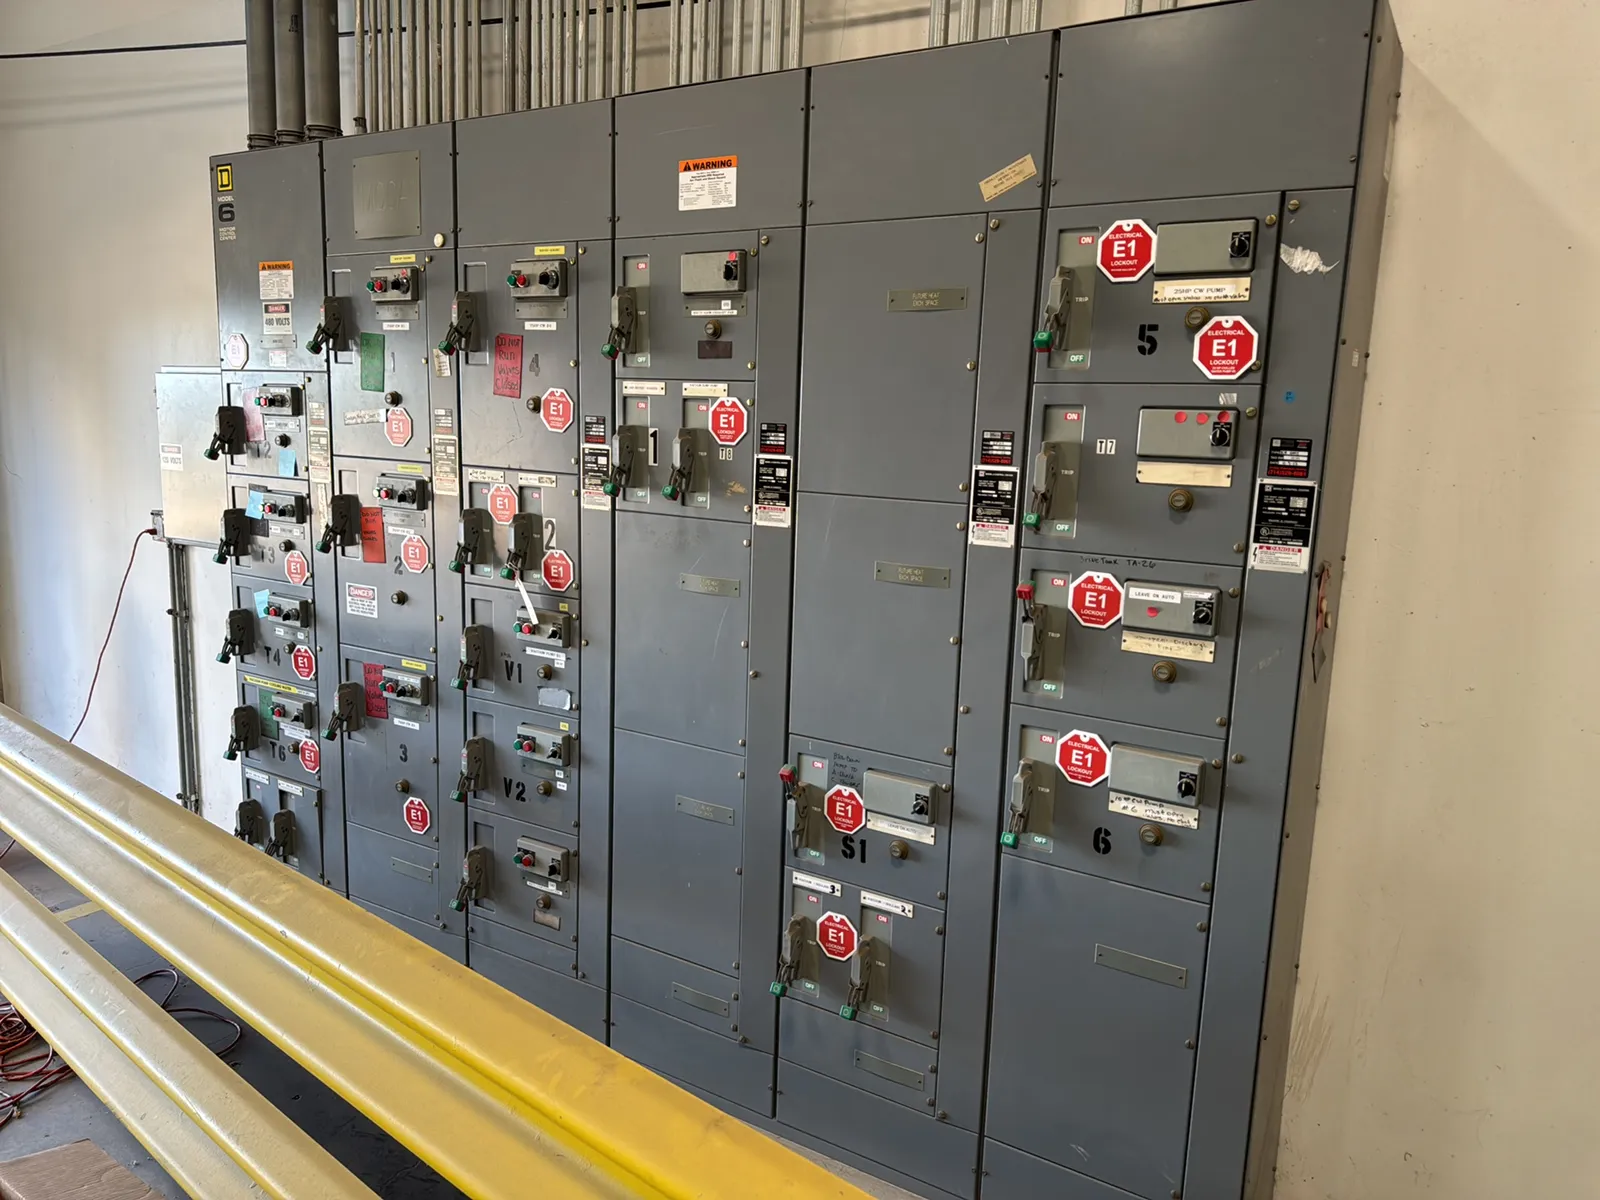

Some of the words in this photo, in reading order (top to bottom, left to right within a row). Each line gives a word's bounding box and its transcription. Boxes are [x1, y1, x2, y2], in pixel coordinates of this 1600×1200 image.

[692, 160, 732, 170] WARNING
[218, 203, 236, 222] 6
[1080, 236, 1093, 244] ON
[1109, 232, 1144, 240] ELECTRICAL
[1113, 239, 1136, 258] E1
[265, 318, 274, 326] 480
[276, 318, 290, 326] VOLTS
[1137, 324, 1159, 356] 5
[1212, 338, 1237, 357] E1
[498, 350, 515, 360] Run
[550, 402, 563, 416] E1
[392, 420, 404, 433] E1
[719, 414, 735, 428] E1
[650, 430, 658, 464] 1
[1098, 440, 1114, 454] T7
[496, 497, 509, 509] E1
[544, 520, 556, 550] 2
[408, 546, 420, 559] E1
[290, 562, 301, 573] E1
[394, 555, 403, 575] 2
[551, 565, 563, 578] E1
[1081, 583, 1114, 592] ELECTRICAL
[1085, 591, 1107, 609] E1
[1080, 608, 1107, 617] LOCKOUT
[264, 646, 281, 667] T4
[298, 656, 308, 668] E1
[504, 660, 522, 683] V1
[269, 740, 286, 762] T6
[1068, 740, 1100, 752] ELECTRICAL
[305, 750, 314, 762] E1
[399, 744, 408, 762] 3
[1071, 749, 1093, 768] E1
[1067, 765, 1093, 775] LOCKOUT
[503, 776, 526, 803] V2
[832, 795, 857, 806] ELECTRICAL
[410, 809, 422, 821] E1
[836, 802, 852, 818] E1
[834, 816, 854, 825] LOCKOUT
[1034, 836, 1046, 844] OFF
[1092, 826, 1112, 855] 6
[810, 849, 821, 858] OFF
[840, 835, 867, 864] S1
[829, 885, 836, 894] 3
[900, 905, 908, 916] 2
[878, 915, 887, 923] ON
[824, 920, 849, 931] ELECTRICAL
[828, 928, 844, 944] E1
[825, 942, 846, 951] LOCKOUT
[805, 982, 815, 990] OFF
[873, 1004, 884, 1013] OFF
